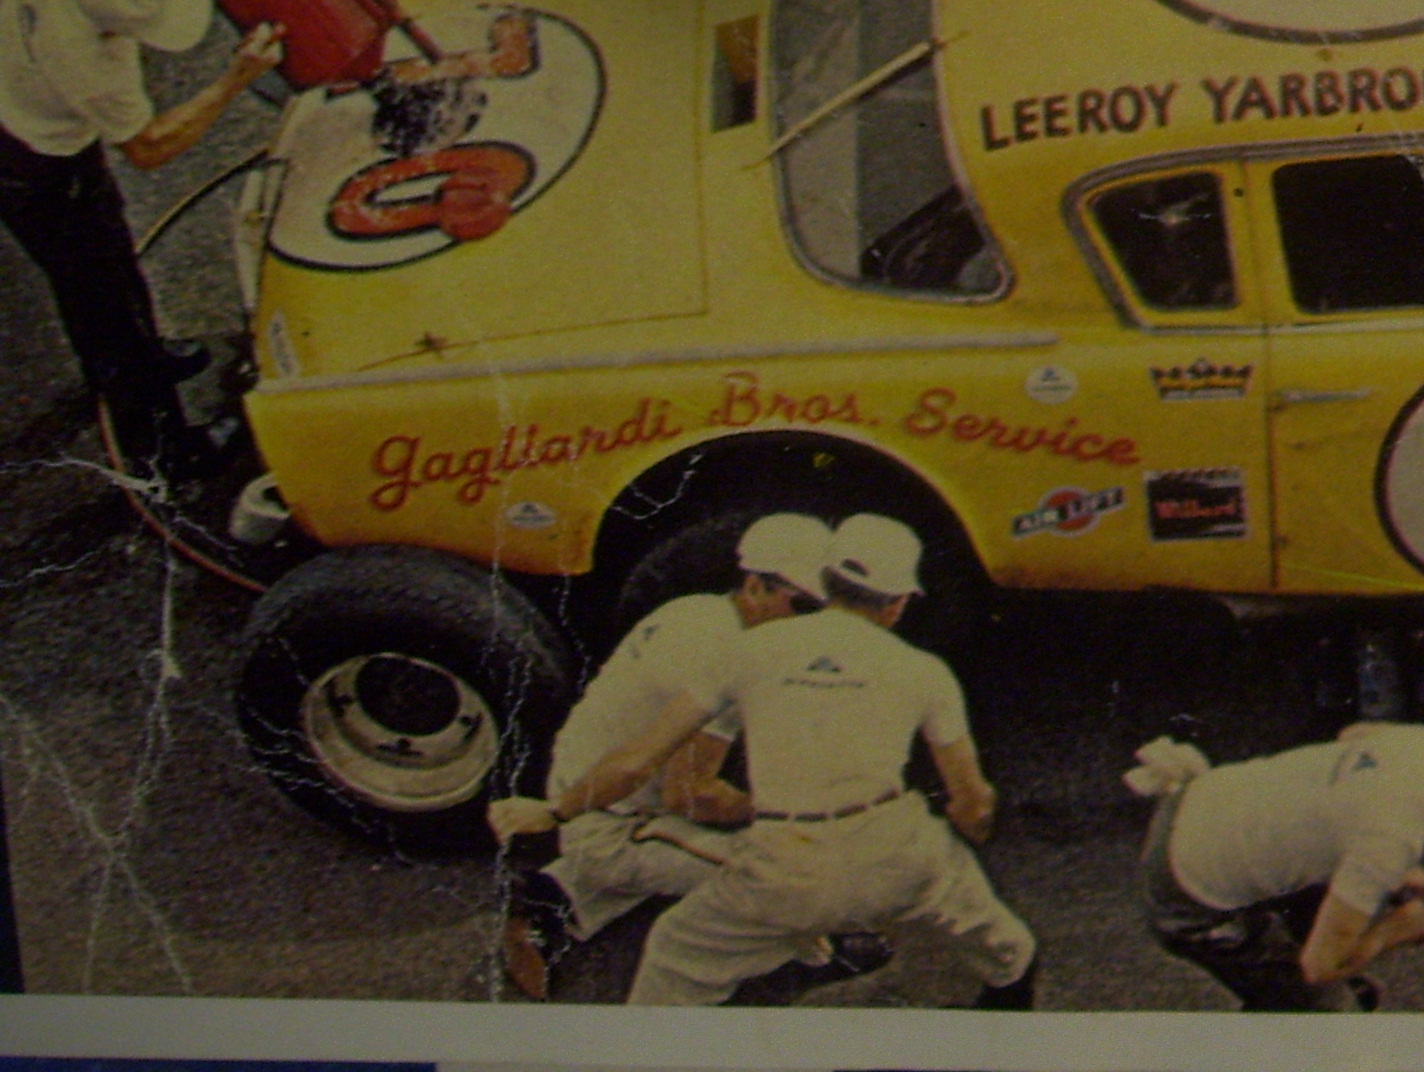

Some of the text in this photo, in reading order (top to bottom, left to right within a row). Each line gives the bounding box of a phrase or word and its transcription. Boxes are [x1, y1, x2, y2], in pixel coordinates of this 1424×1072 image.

[981, 82, 1177, 152] LEEROY
[704, 371, 881, 428] Bros.
[904, 388, 1141, 466] Service
